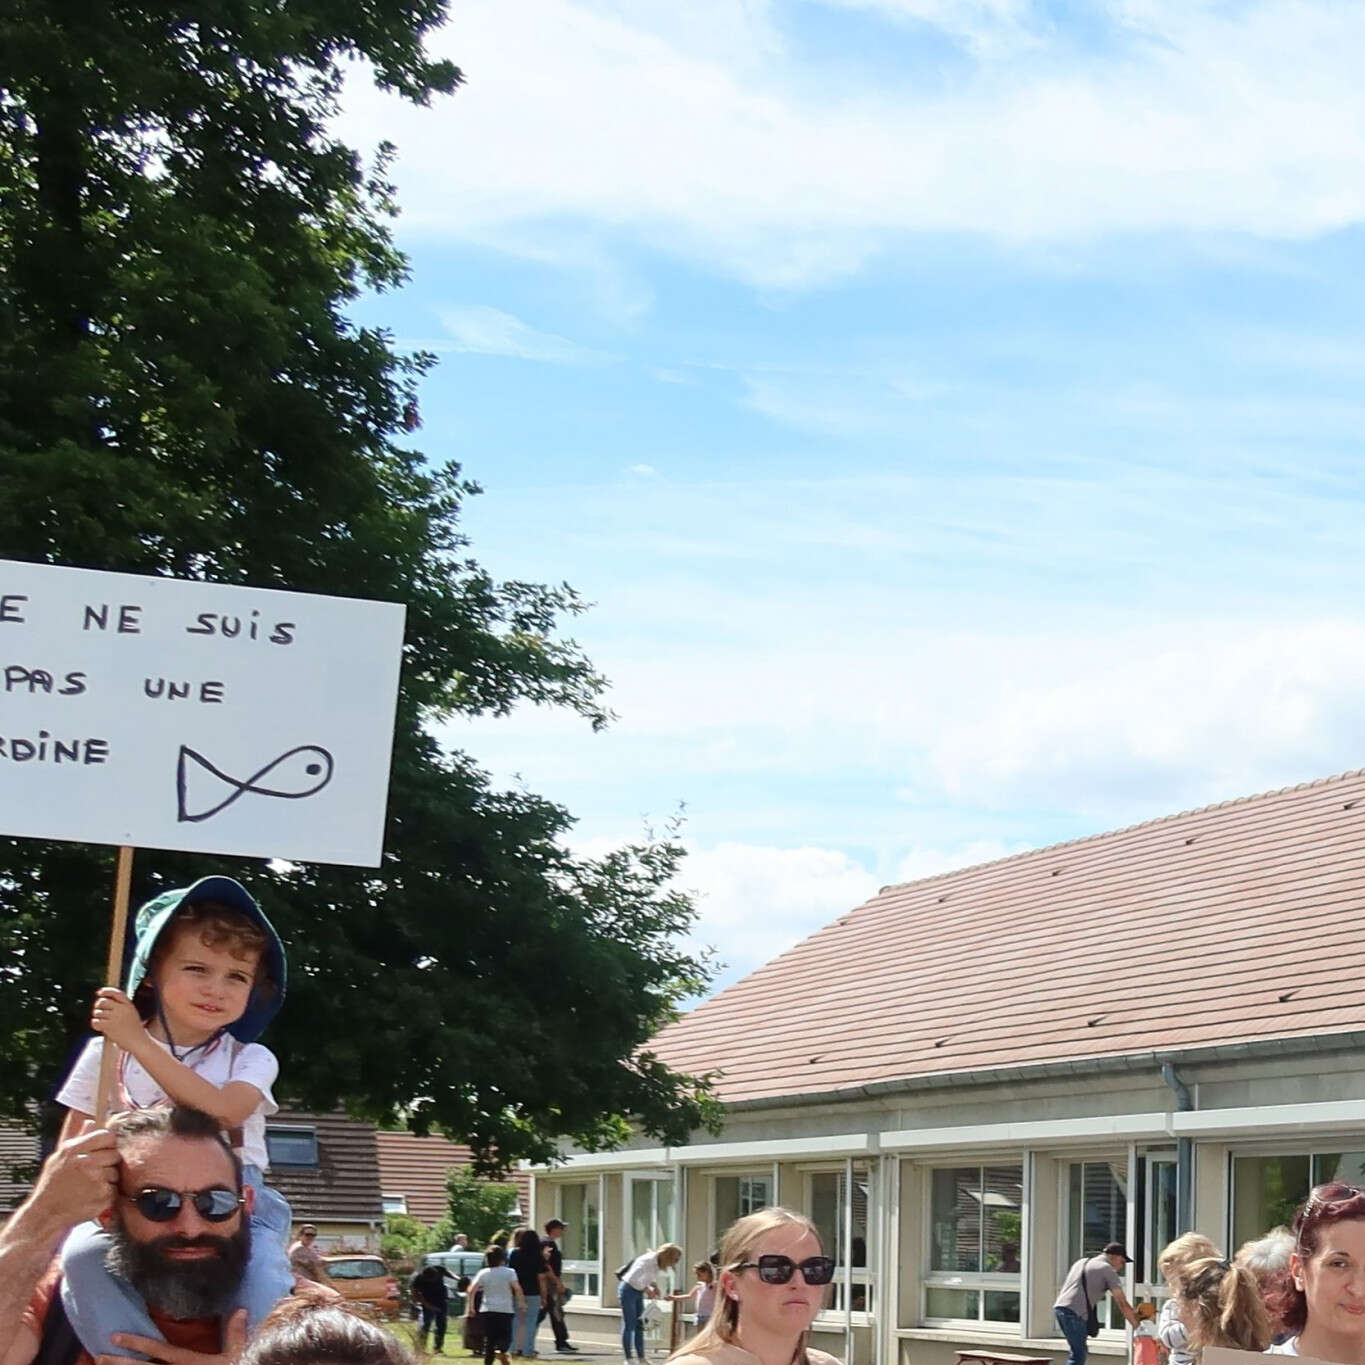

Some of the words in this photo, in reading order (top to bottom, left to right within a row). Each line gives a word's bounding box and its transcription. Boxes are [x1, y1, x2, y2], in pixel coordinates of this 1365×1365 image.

[83, 604, 141, 633] NE
[5, 665, 87, 695] PAS
[145, 677, 224, 703] UNE
